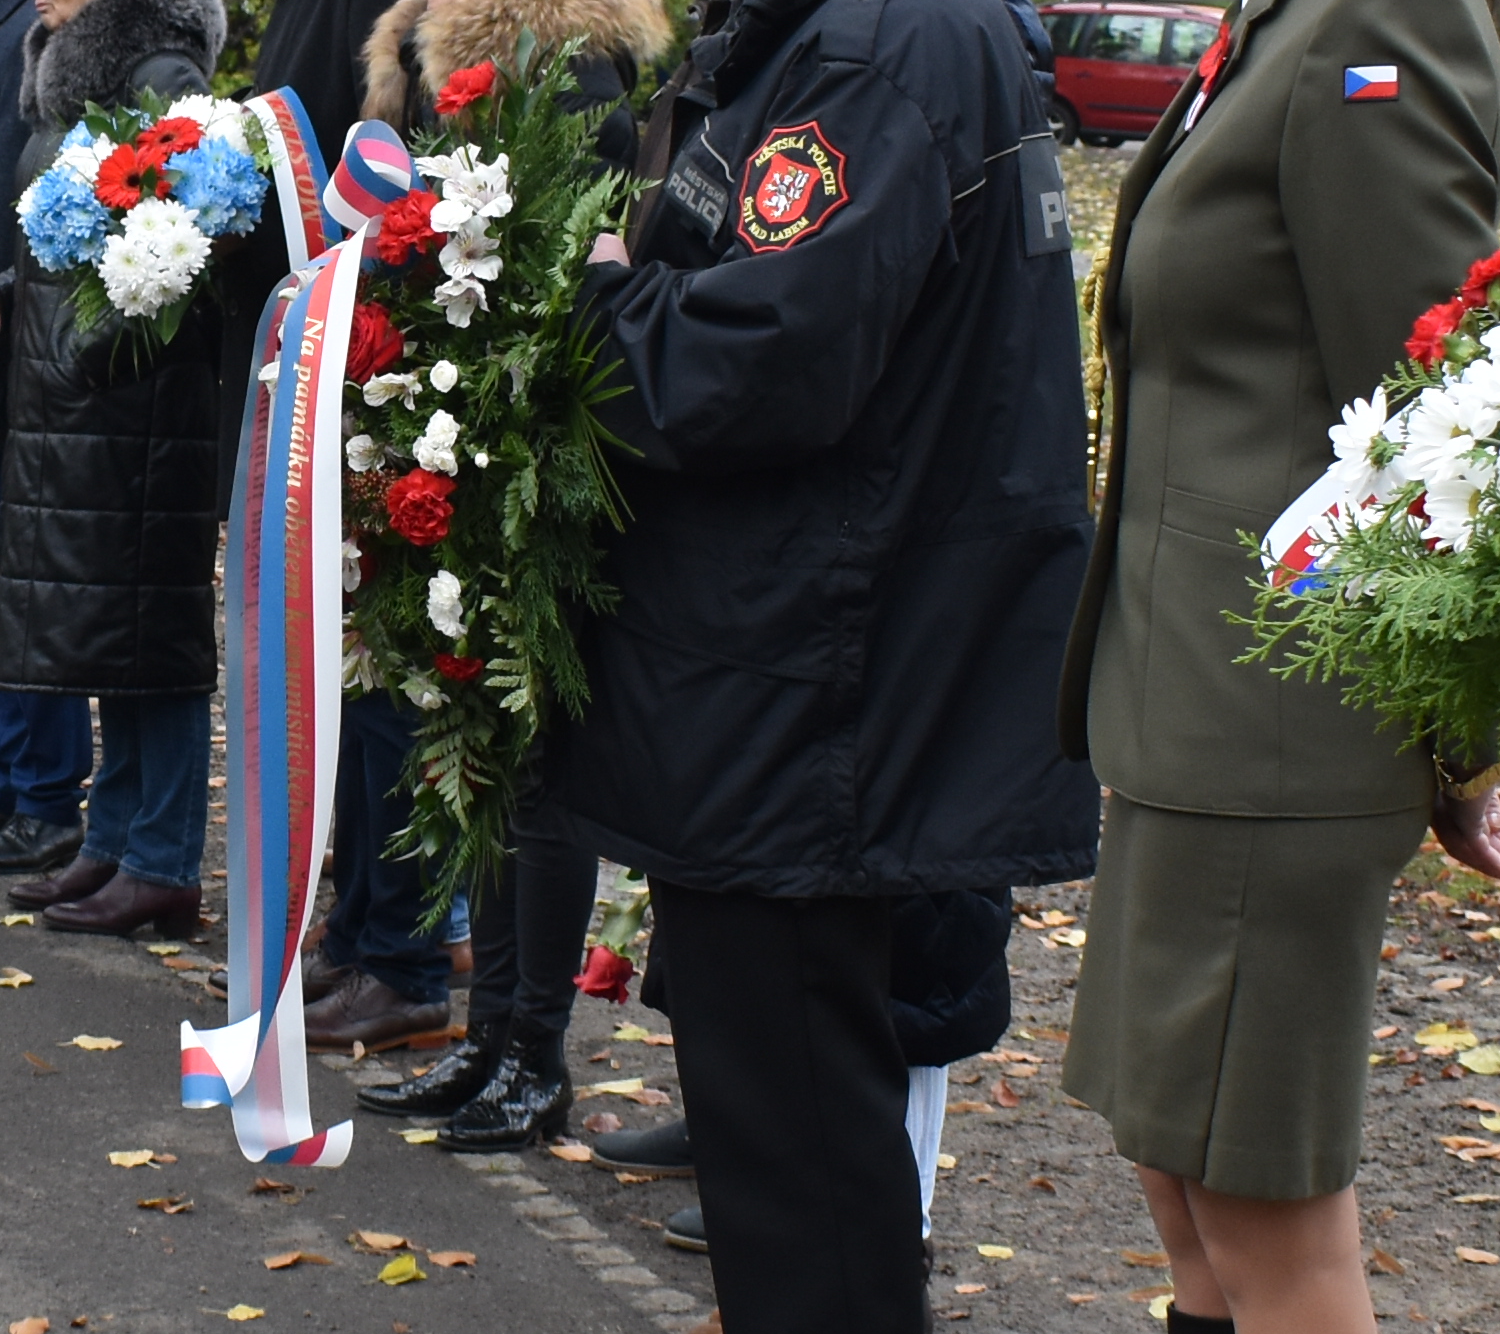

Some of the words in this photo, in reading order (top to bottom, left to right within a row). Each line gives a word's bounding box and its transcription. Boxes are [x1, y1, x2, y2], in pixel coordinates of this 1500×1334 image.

[807, 143, 837, 195] POLICIE
[748, 223, 768, 240] NAD
[769, 216, 810, 242] LABEM
[301, 315, 325, 357] Na
[287, 362, 312, 488] památku
